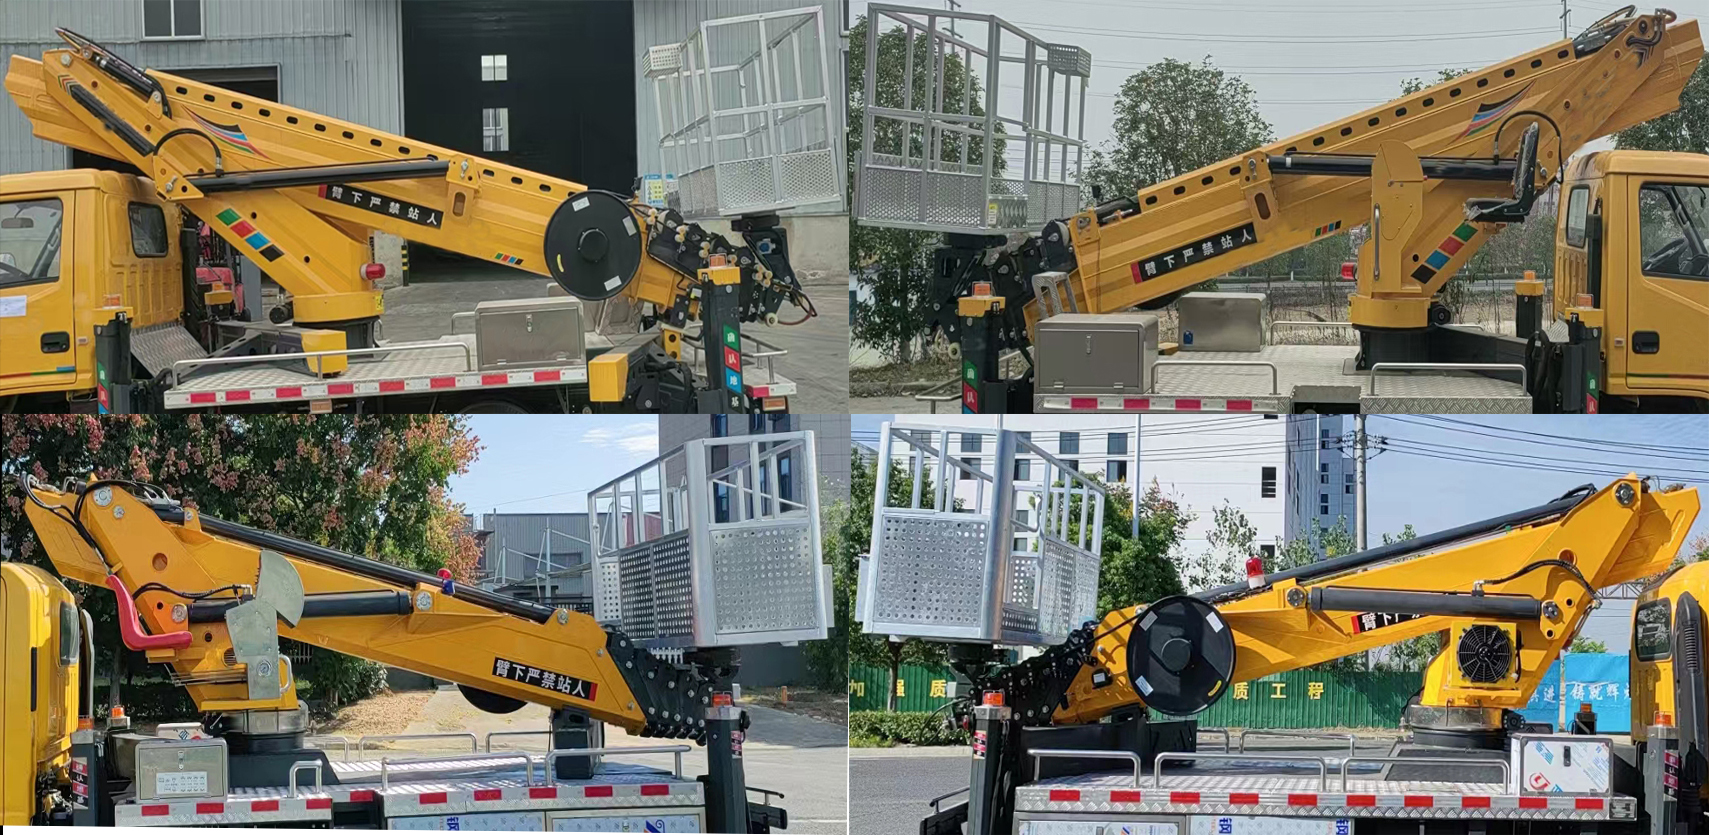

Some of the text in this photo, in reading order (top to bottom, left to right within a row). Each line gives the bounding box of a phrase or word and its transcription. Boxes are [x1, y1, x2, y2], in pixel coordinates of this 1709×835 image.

[332, 186, 437, 225] 臂下严禁站人
[1145, 229, 1252, 276] 臂下严禁站人
[1362, 612, 1420, 631] 臂下
[496, 659, 586, 698] 臂下严禁站人
[1219, 818, 1232, 834] 钢
